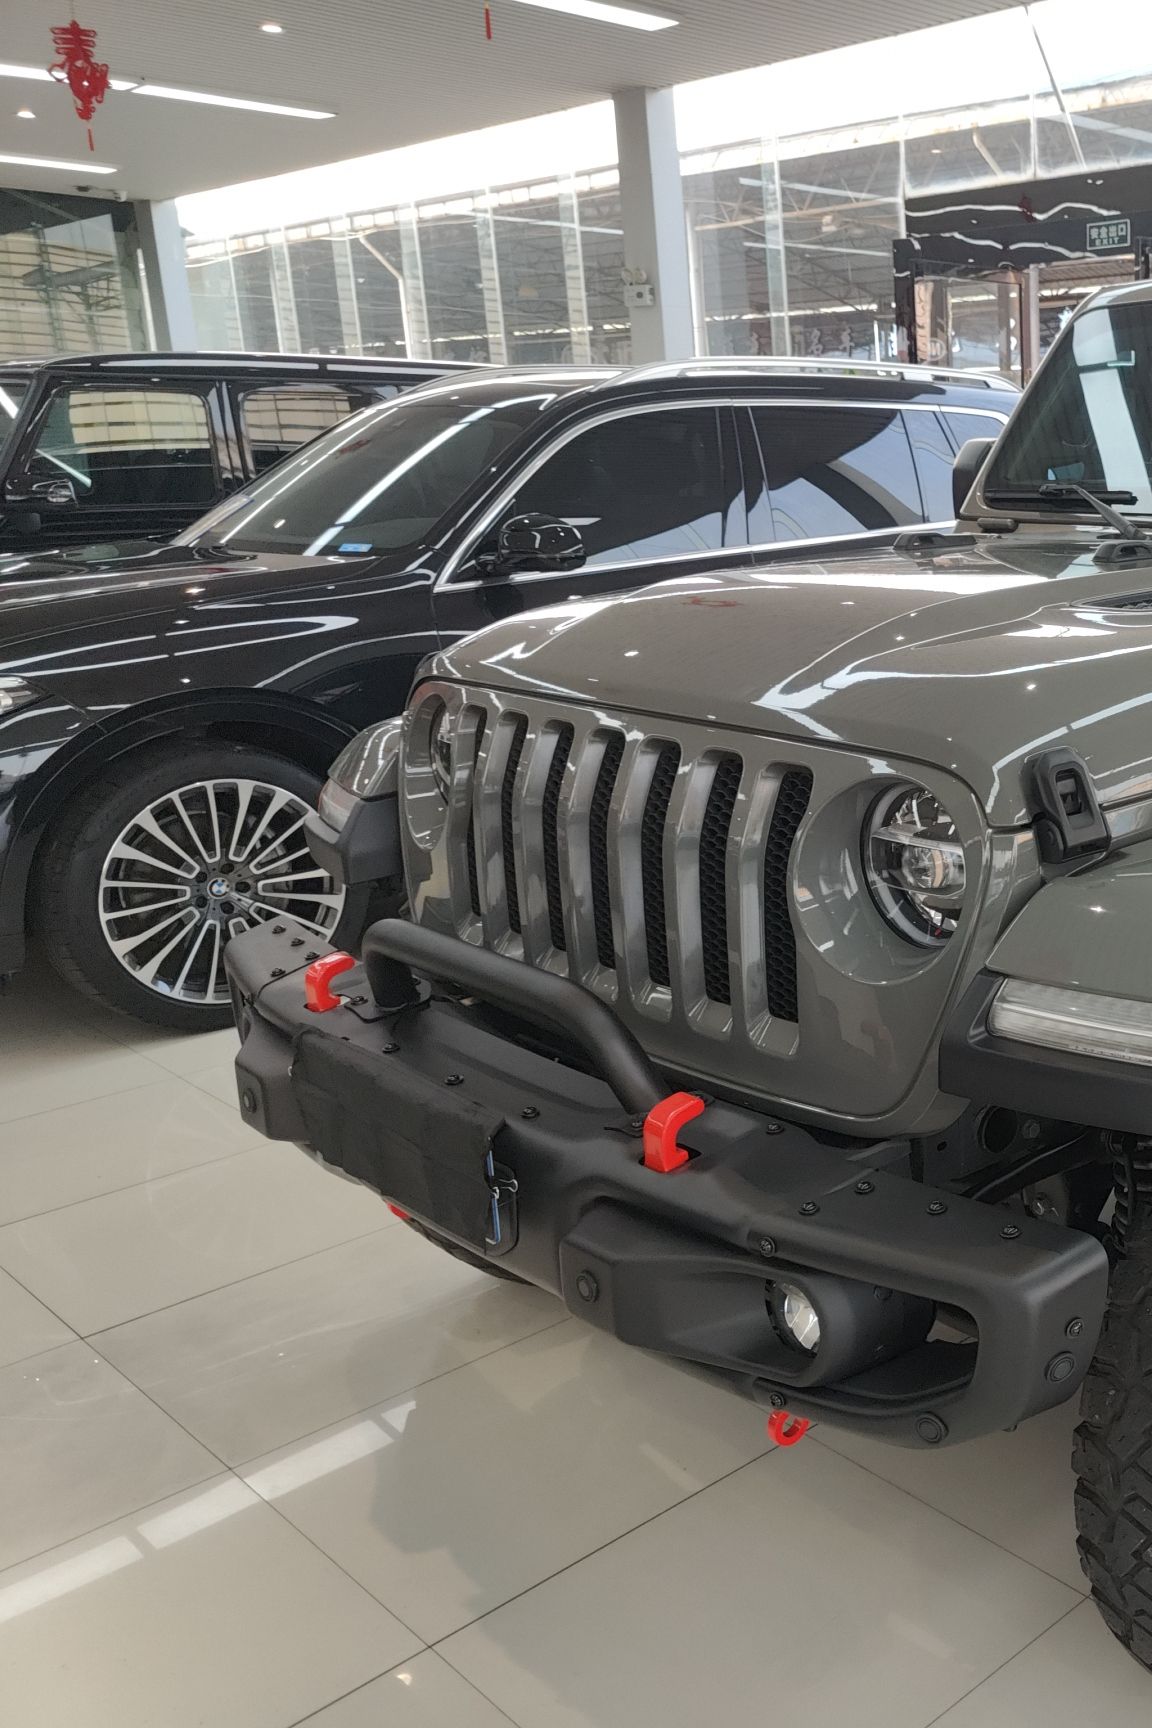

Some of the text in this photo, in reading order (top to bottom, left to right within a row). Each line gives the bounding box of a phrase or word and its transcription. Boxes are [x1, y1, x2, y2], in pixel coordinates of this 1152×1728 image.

[1090, 223, 1126, 239] 安全出口
[1095, 237, 1120, 246] EXIT
